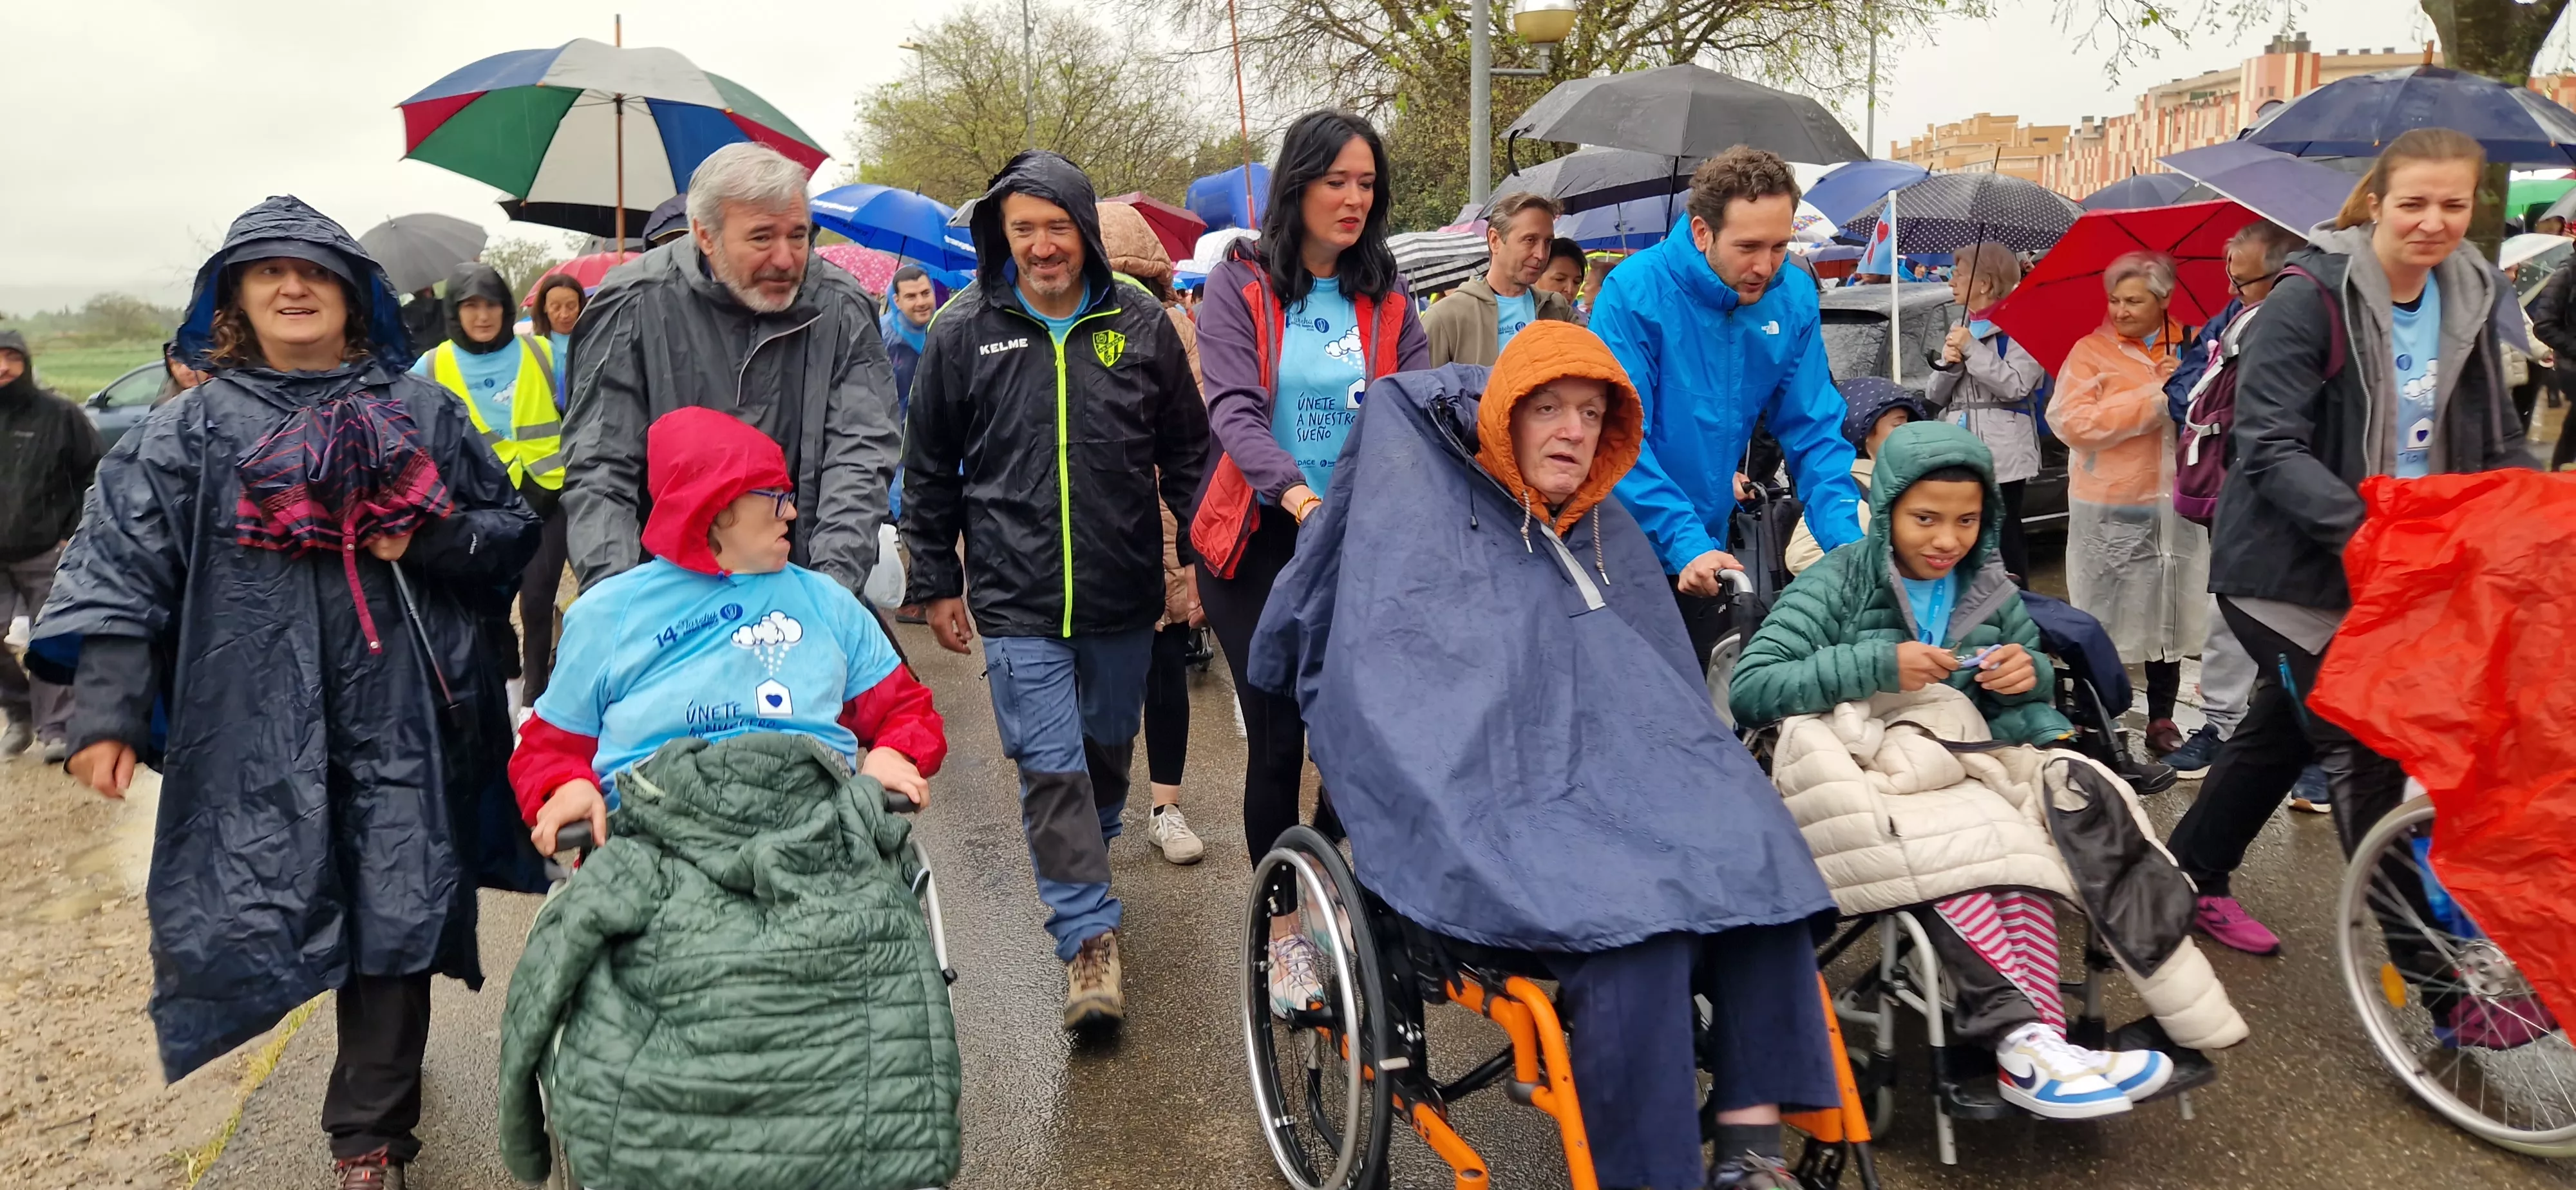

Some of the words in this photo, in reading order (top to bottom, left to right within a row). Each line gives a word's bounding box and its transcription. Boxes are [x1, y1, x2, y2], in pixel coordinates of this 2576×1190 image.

[980, 338, 1028, 355] KELME
[1298, 392, 1336, 411] ÚNETE
[1296, 413, 1304, 426] A
[1297, 426, 1331, 442] SUEÑO
[653, 625, 678, 648] 14
[686, 699, 741, 724] ÚNETE
